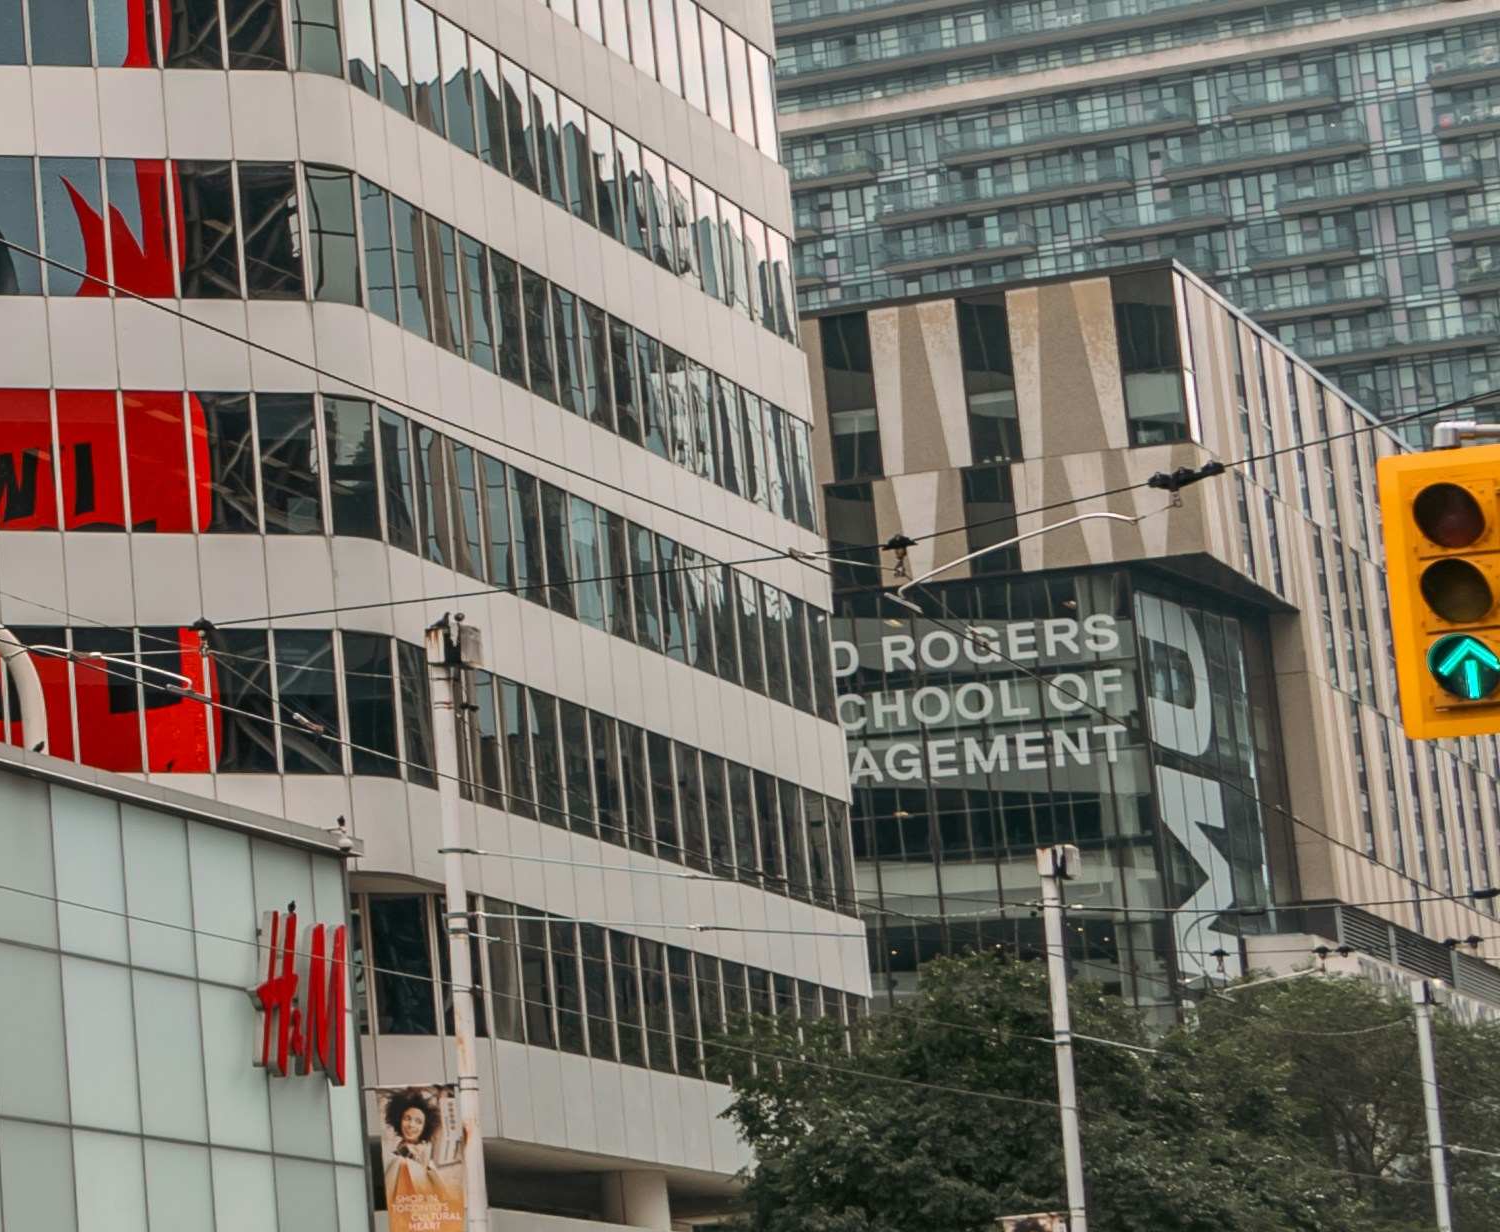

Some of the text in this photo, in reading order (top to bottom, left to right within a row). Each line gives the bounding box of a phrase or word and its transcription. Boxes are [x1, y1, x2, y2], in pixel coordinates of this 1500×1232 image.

[882, 613, 1121, 672] ROGERS
[835, 668, 1124, 733] CHOOL OF
[850, 724, 1130, 786] AGEMENT
[250, 909, 347, 1087] H&M
[408, 1222, 441, 1231] HEART
[410, 1212, 462, 1222] CULTURAL
